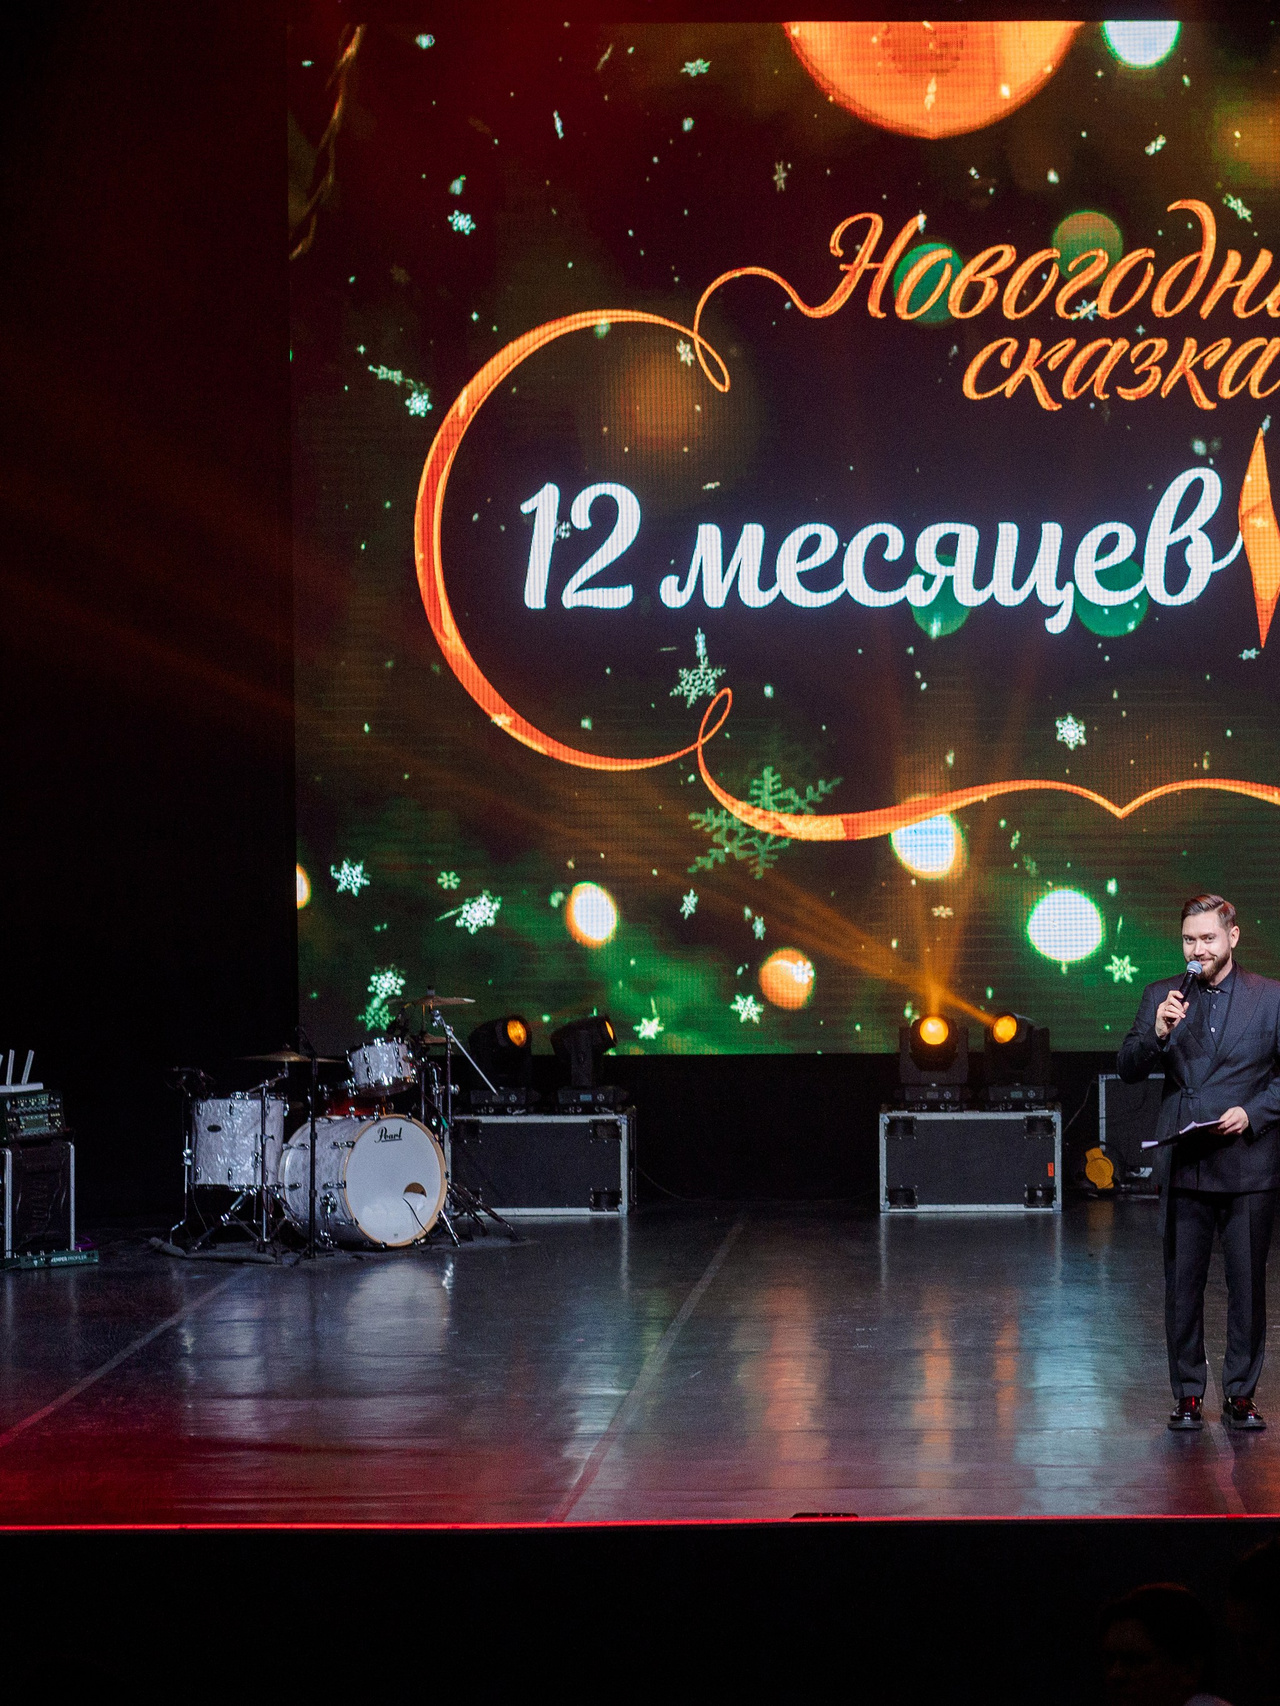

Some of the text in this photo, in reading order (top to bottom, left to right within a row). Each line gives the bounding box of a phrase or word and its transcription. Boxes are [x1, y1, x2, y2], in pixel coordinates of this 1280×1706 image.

[520, 482, 641, 609] 12
[659, 467, 1244, 633] месяцев
[374, 1126, 402, 1143] Pearl
